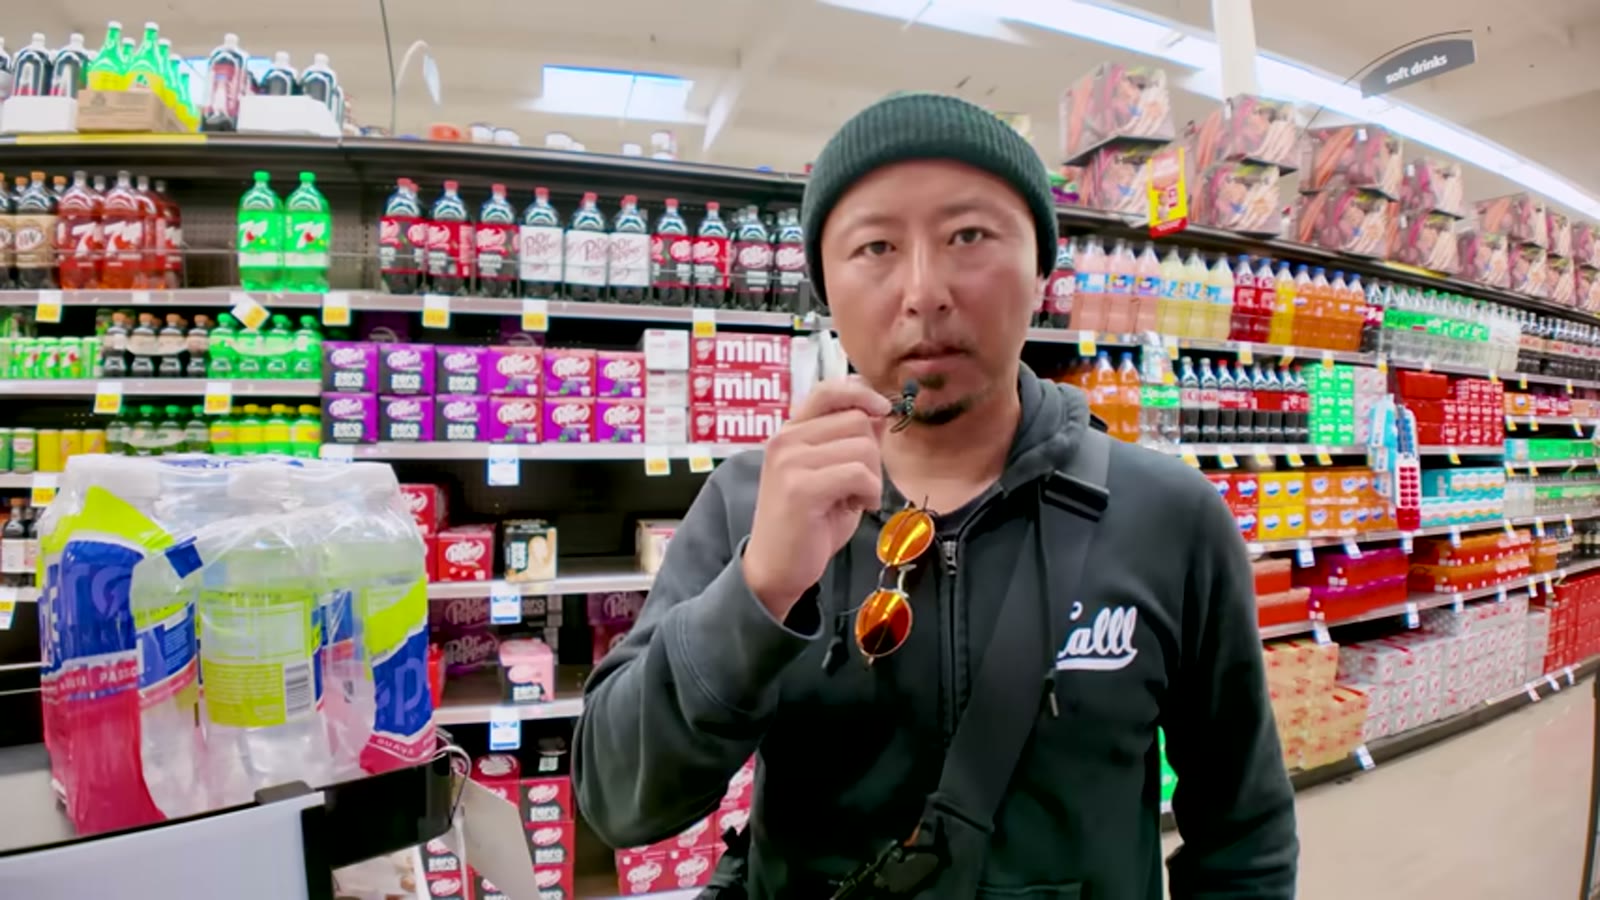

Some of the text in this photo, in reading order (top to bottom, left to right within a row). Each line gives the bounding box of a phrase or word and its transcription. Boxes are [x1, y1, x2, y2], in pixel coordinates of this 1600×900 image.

[1385, 54, 1448, 84] soft drinks
[717, 336, 780, 362] mini
[714, 372, 780, 400] mini
[717, 409, 781, 437] mini
[446, 635, 493, 664] Dr Pepper
